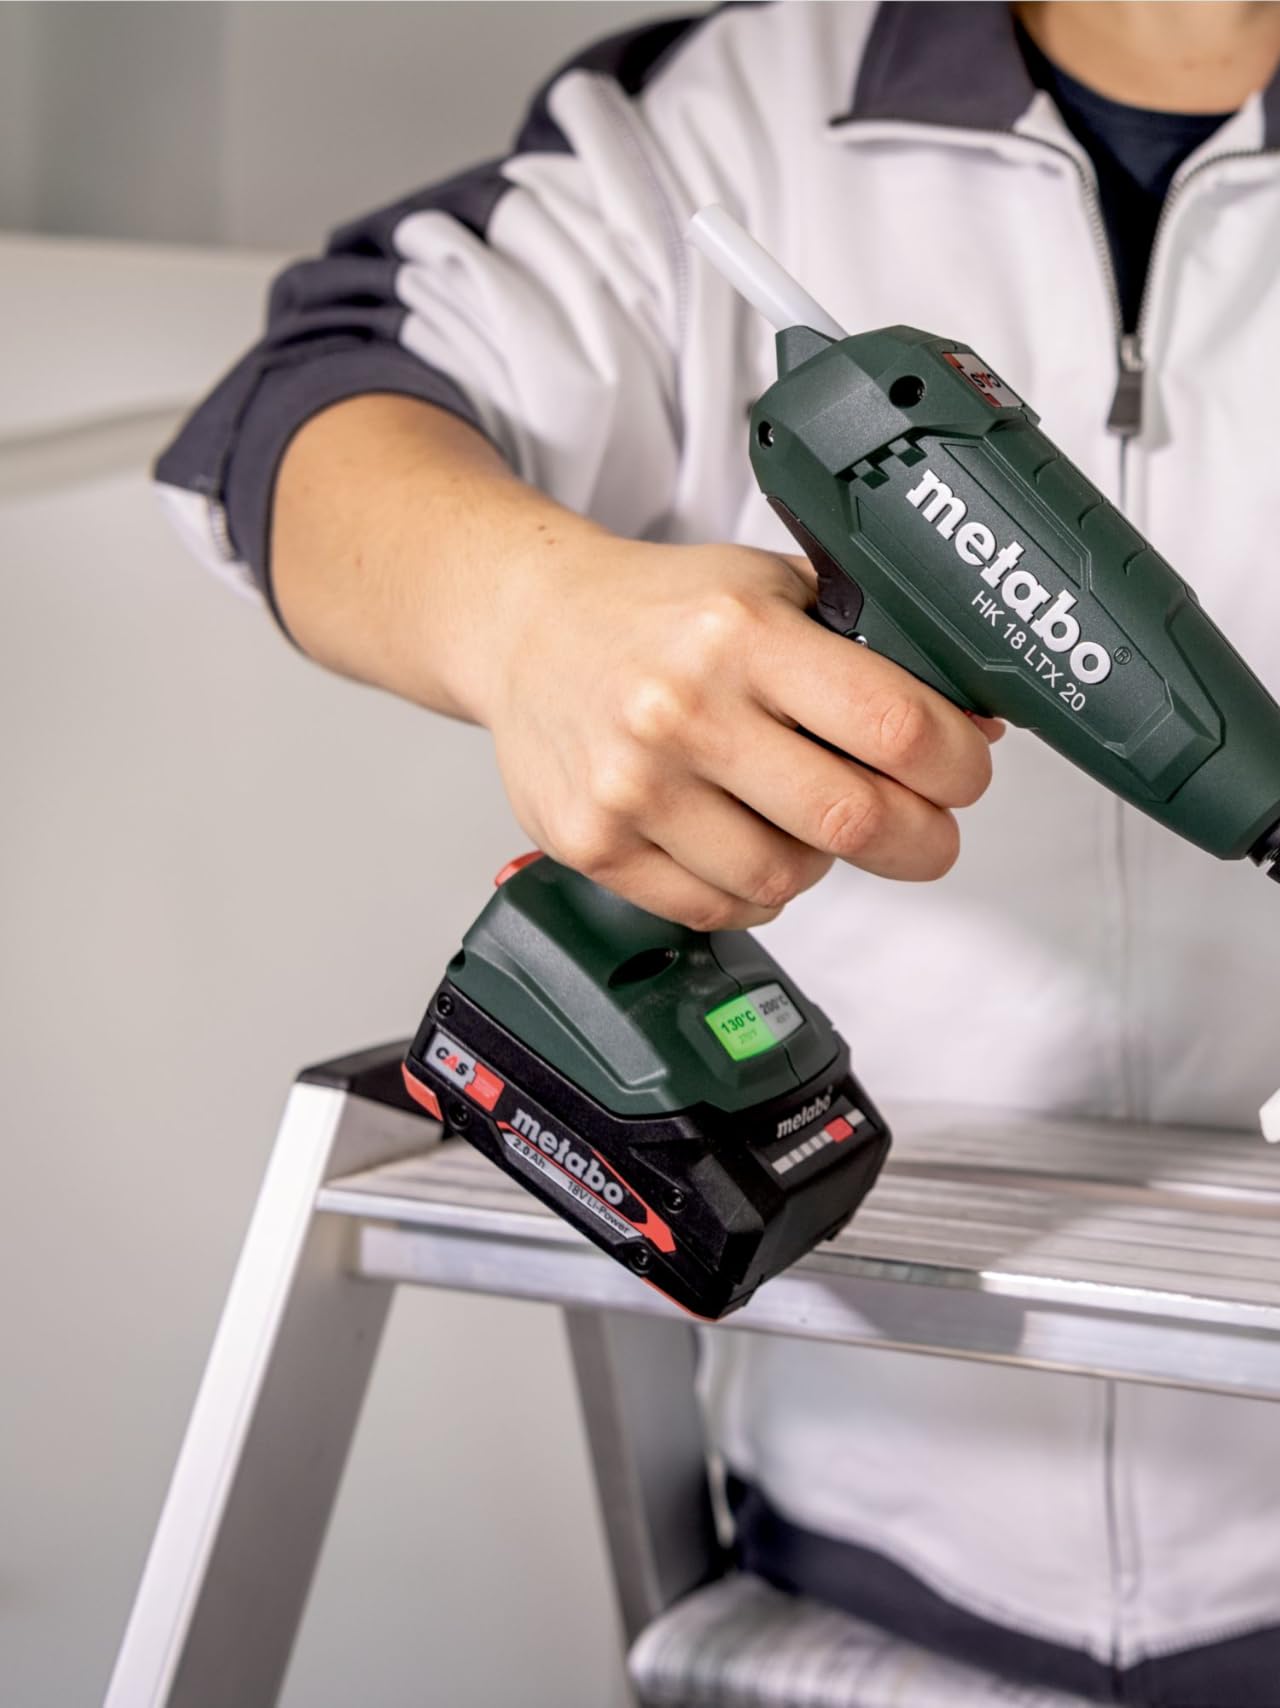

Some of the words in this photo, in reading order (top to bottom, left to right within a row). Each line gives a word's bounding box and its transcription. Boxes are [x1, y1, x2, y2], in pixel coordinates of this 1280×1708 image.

[905, 469, 1112, 685] metabo
[971, 590, 1005, 627] HK
[1003, 623, 1027, 650] 18
[1024, 645, 1064, 688] LTX
[1059, 682, 1086, 711] 20
[721, 1010, 756, 1034] 130°C
[435, 1047, 469, 1076] CAS
[776, 1094, 831, 1138] metabo
[510, 1108, 624, 1205] metabo
[513, 1137, 531, 1157] 2.0
[528, 1150, 546, 1169] Ah
[566, 1180, 588, 1201] 18V
